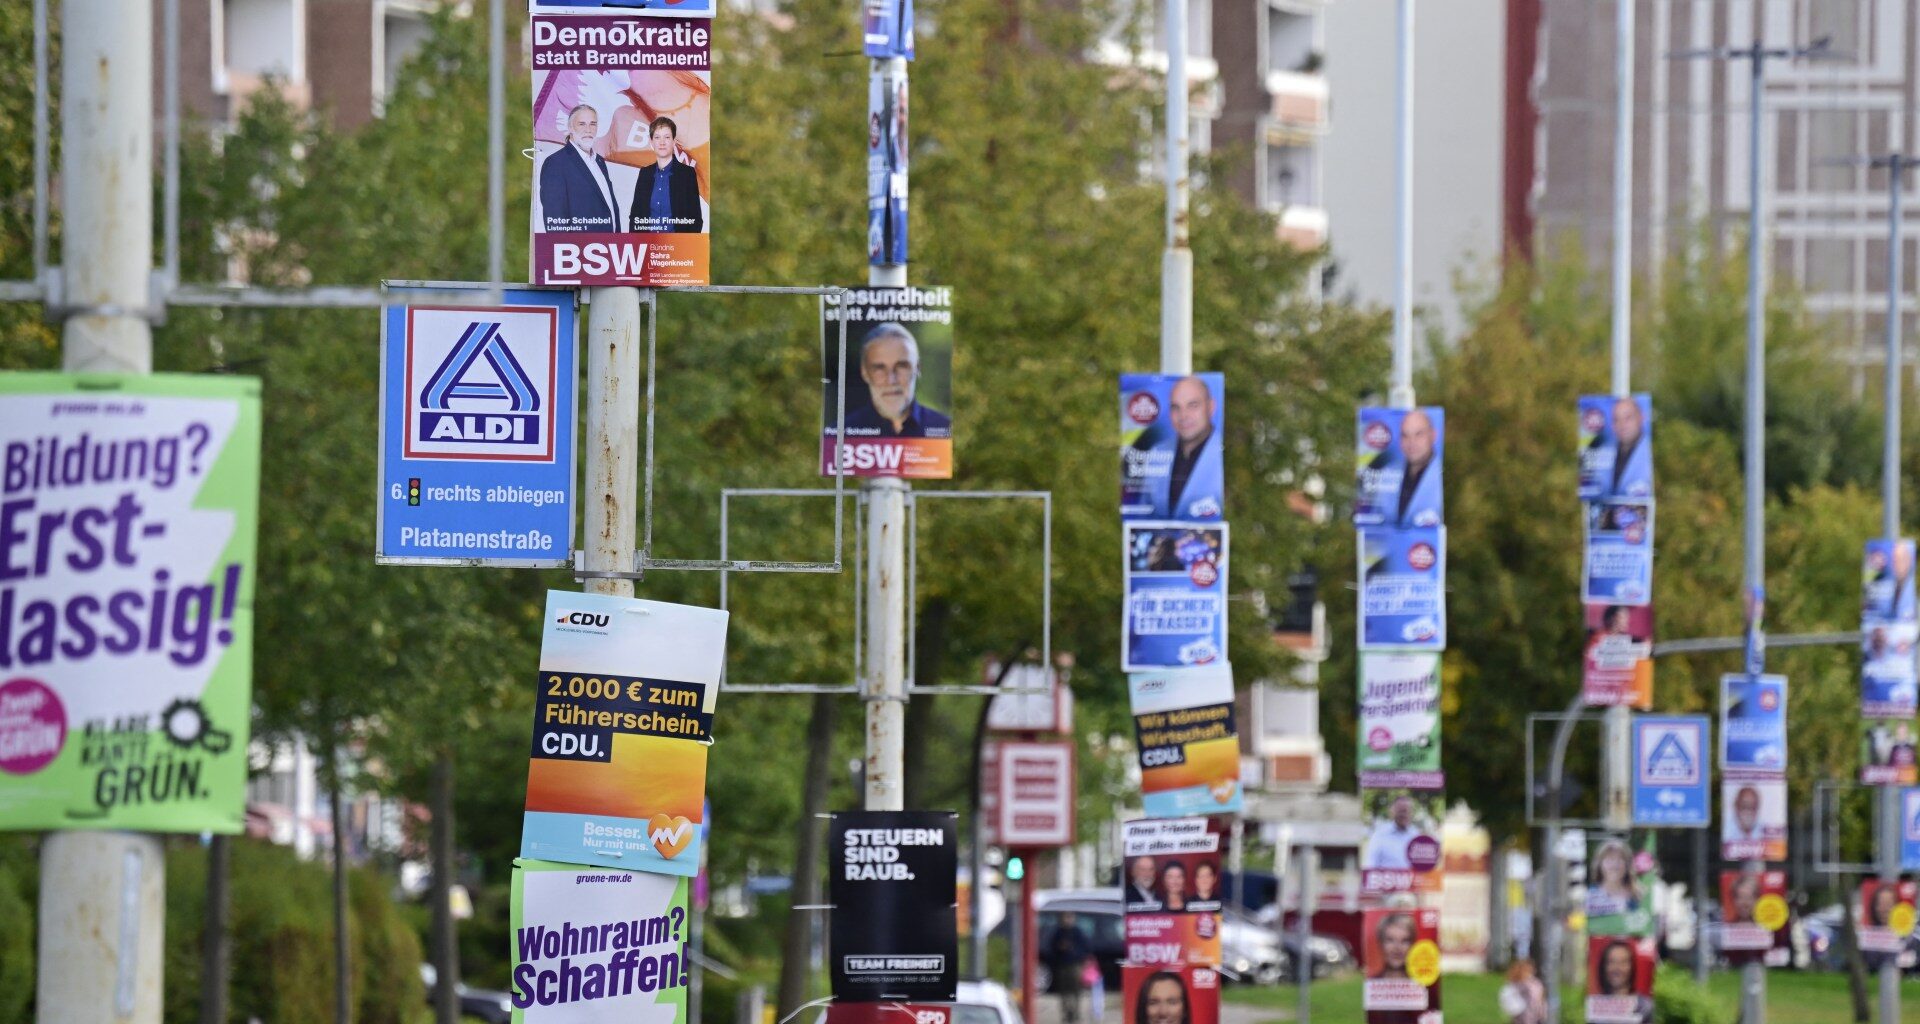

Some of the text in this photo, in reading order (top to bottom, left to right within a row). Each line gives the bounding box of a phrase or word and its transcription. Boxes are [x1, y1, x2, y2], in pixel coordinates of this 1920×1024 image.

[535, 21, 708, 46] Demokratie
[536, 50, 707, 65] statt Brandmauern!
[662, 217, 695, 225] Firnhaber
[554, 243, 647, 275] BSW
[866, 306, 951, 325] Aufrüstung
[430, 416, 525, 441] ALDI
[3, 423, 210, 494] Bildung?
[834, 444, 903, 469] BSW
[391, 483, 564, 507] 6. rechts abbiegen
[0, 493, 168, 580] Erst-
[401, 527, 552, 551] Platanenstraße
[570, 612, 609, 627] CDU
[548, 676, 697, 707] 2.000 € zum
[545, 703, 705, 736] Führerschein.
[1168, 706, 1230, 726] können
[541, 732, 605, 757] CDU.
[95, 752, 209, 808] GRÜN.
[584, 822, 641, 839] Besser.
[844, 829, 943, 846] STEUERN
[583, 837, 649, 852] Nur mit uns.
[844, 847, 899, 863] SIND
[576, 873, 632, 884] gruene-mv.de
[845, 864, 915, 880] RAUB.
[517, 906, 685, 962] Wohnraum?
[849, 959, 940, 970] TEAM FREIHEIT
[1129, 943, 1181, 963] BSW
[511, 942, 688, 1009] Schaffen!
